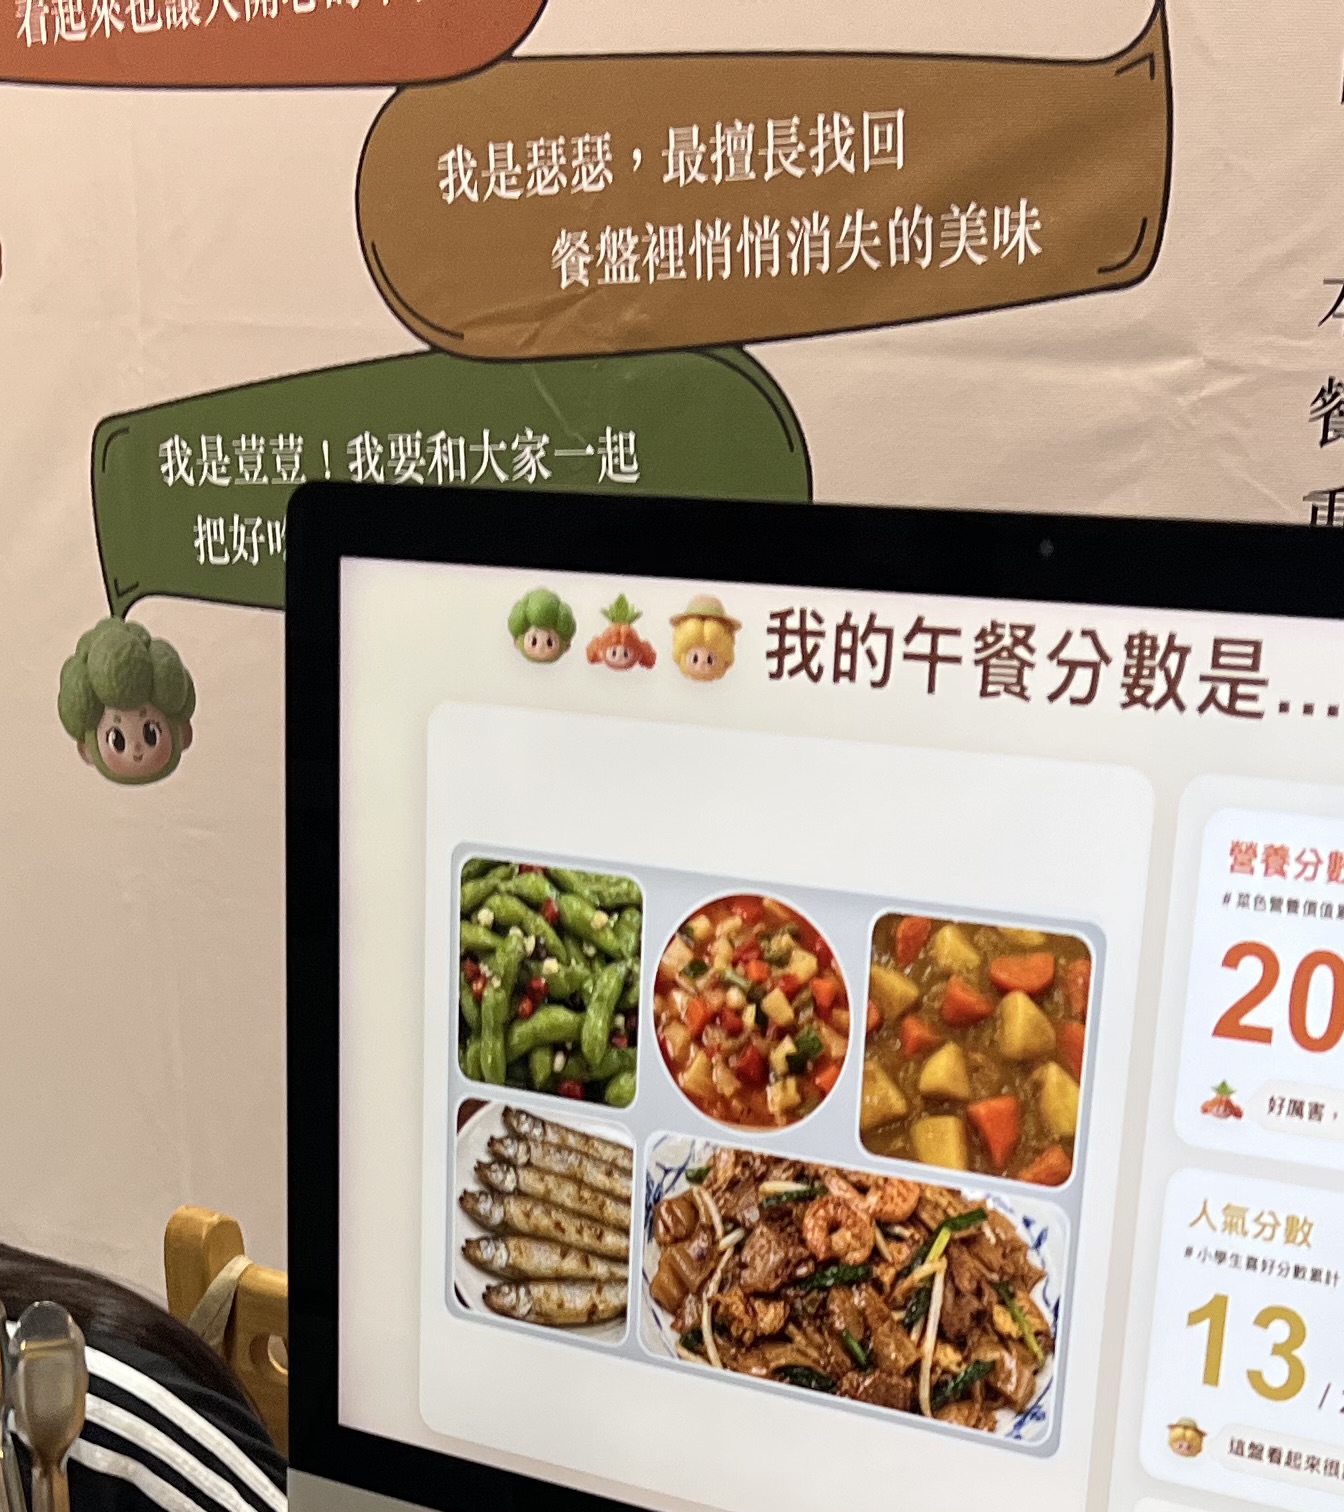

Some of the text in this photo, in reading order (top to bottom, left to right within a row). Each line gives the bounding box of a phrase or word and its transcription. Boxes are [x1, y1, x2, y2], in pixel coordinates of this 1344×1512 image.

[438, 108, 906, 205] 我是瑟瑟，最擅長找回
[551, 197, 1044, 291] 餐盤裡悄悄消失的美味
[158, 426, 641, 487] 我是荳荳！我要和大家一起
[1188, 1198, 1315, 1249] 人氣分數
[1197, 1249, 1341, 1288] 小學生喜好分數累計
[1186, 1292, 1308, 1402] 13
[1317, 1383, 1331, 1411] /
